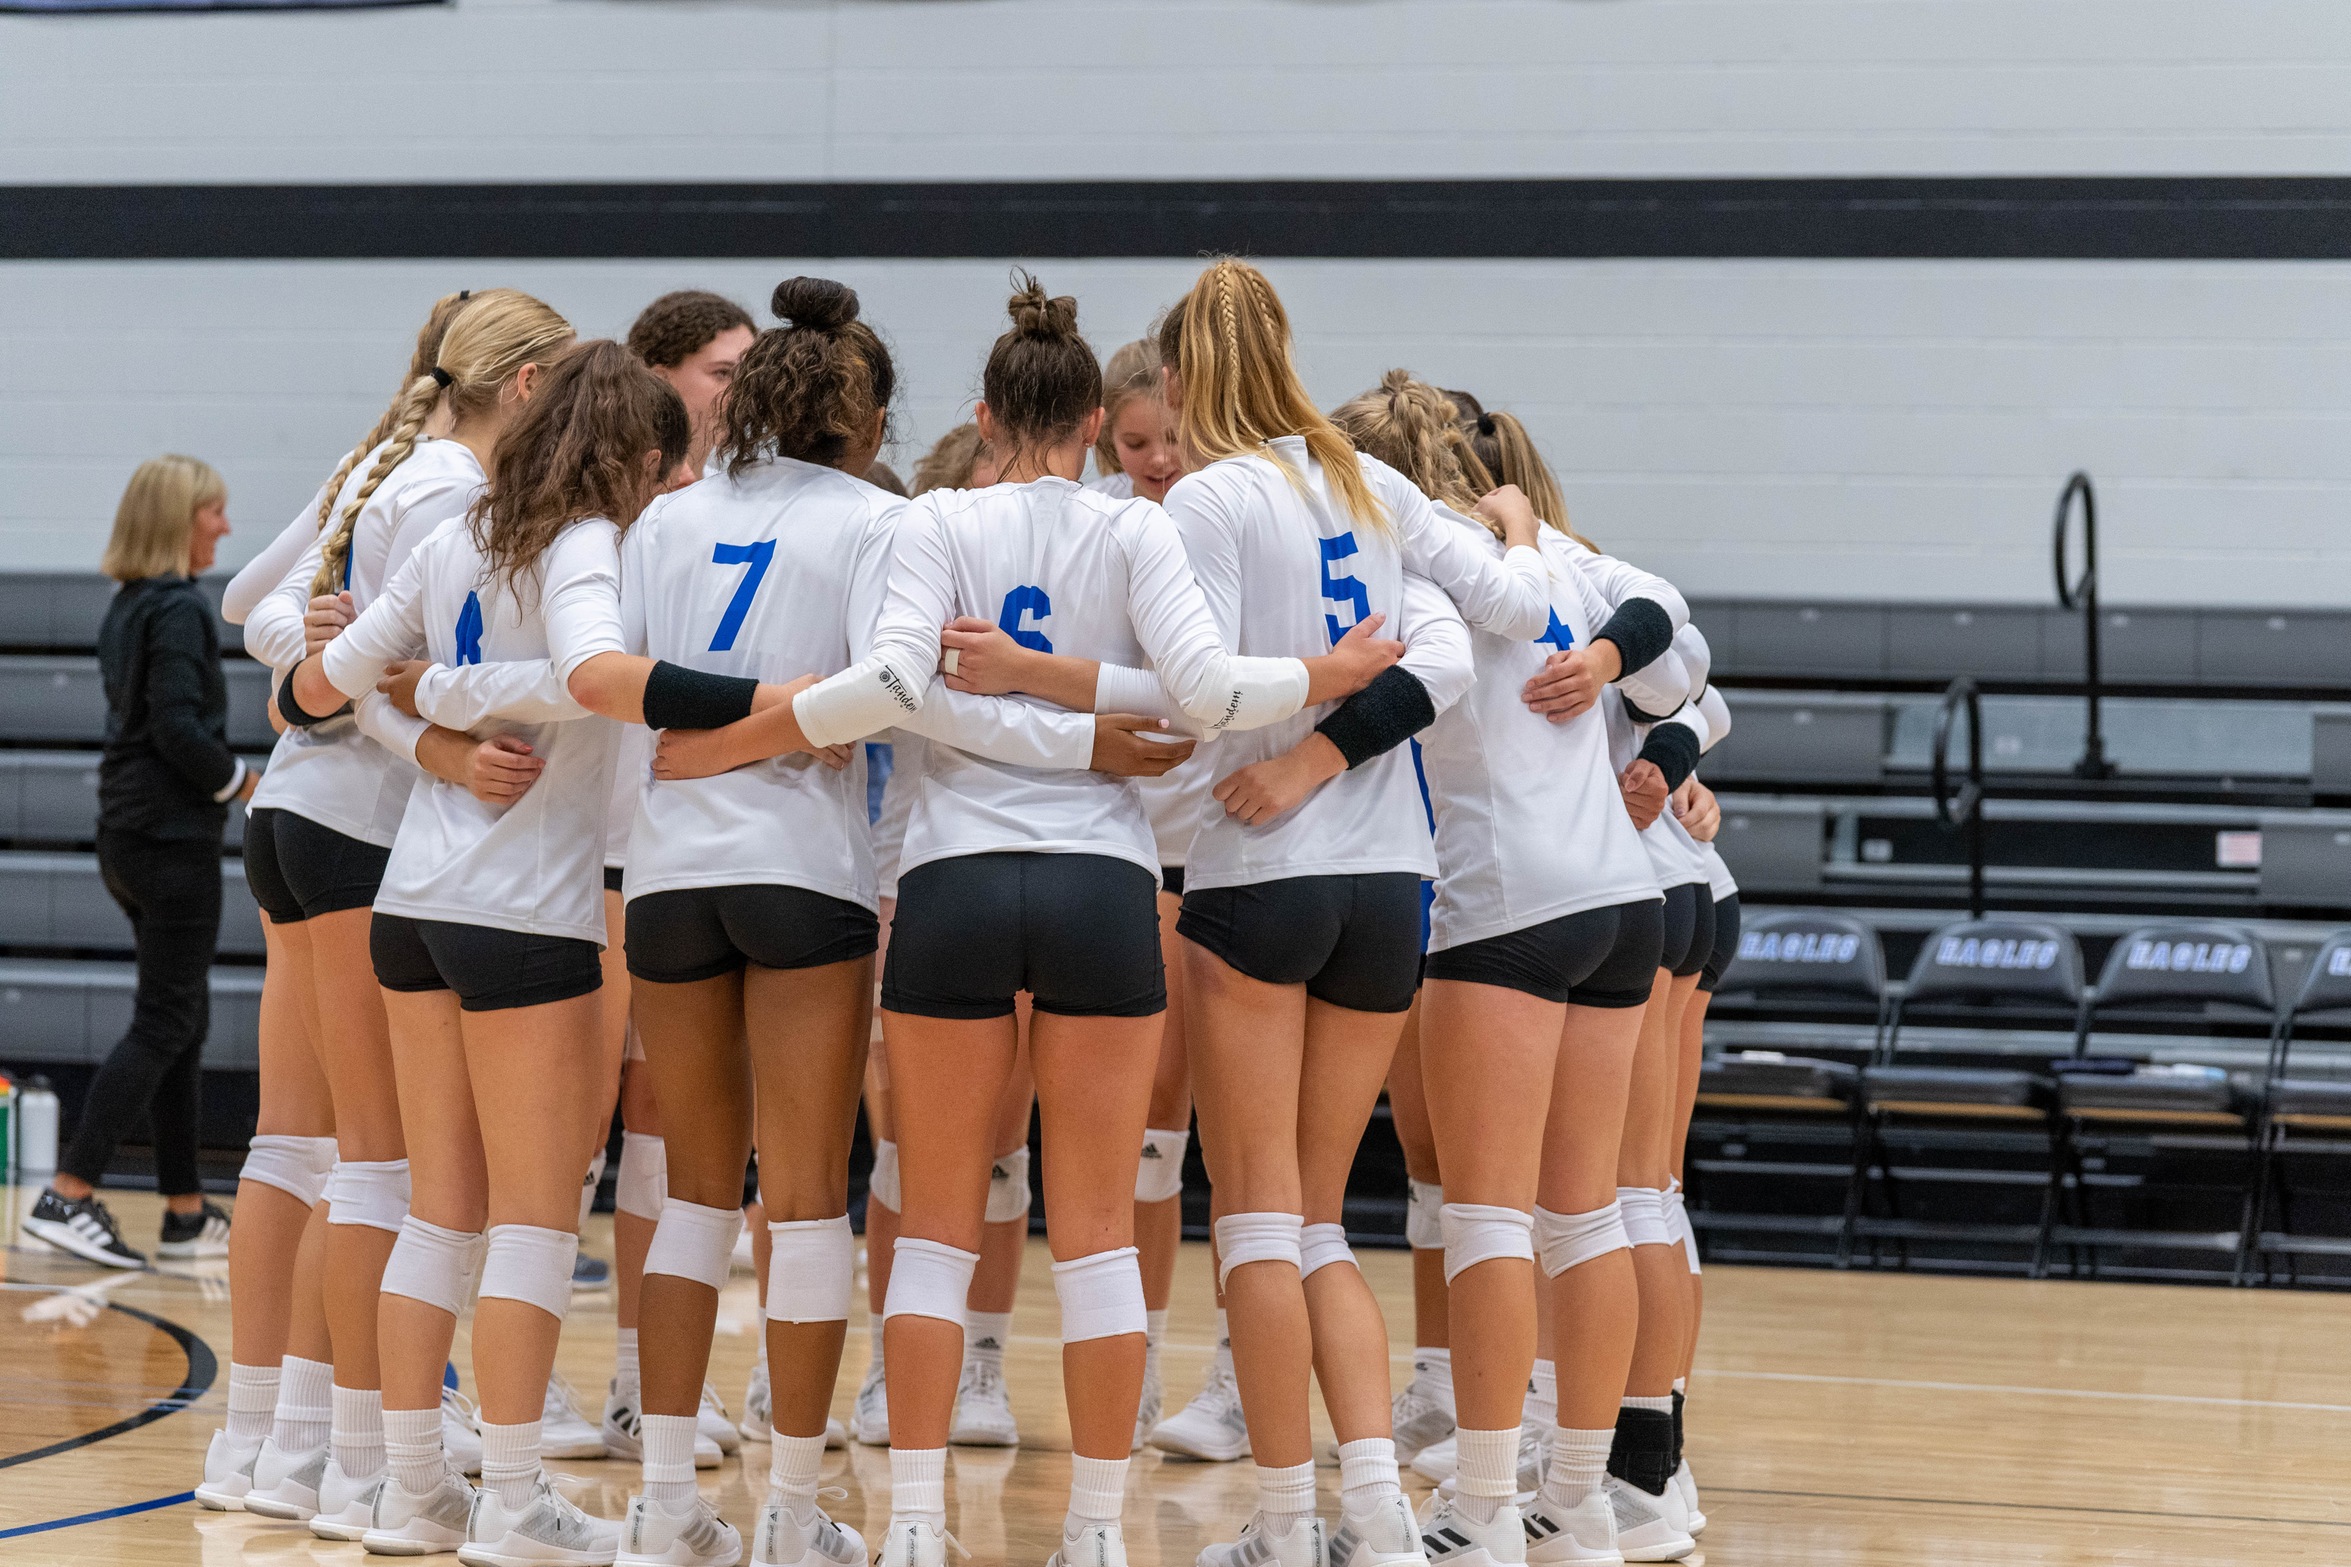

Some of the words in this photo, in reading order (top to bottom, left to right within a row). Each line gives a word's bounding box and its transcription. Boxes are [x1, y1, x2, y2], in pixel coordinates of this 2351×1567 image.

[708, 538, 777, 651] 7
[1318, 531, 1371, 647] 5
[999, 585, 1053, 654] 6
[1533, 603, 1575, 651] 4
[1737, 931, 1860, 963] EAGLES
[1936, 937, 2060, 969] EAGLES
[2127, 941, 2252, 973] EAGLES
